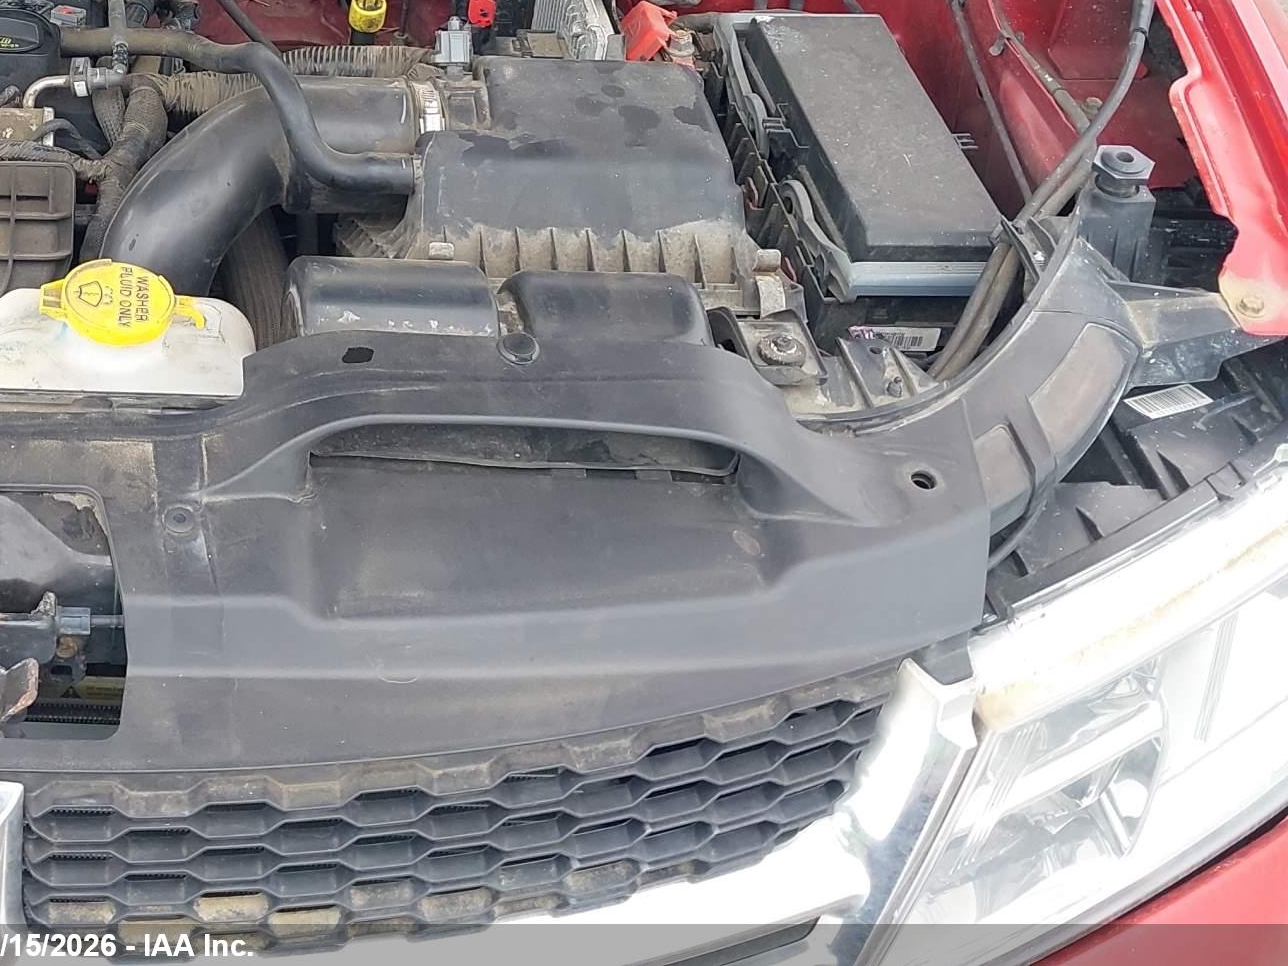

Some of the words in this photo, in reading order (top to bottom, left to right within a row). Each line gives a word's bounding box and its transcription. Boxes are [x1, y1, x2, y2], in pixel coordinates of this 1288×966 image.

[119, 266, 133, 298] FLUID
[118, 299, 132, 328] ONLY
[135, 275, 150, 322] WASHER
